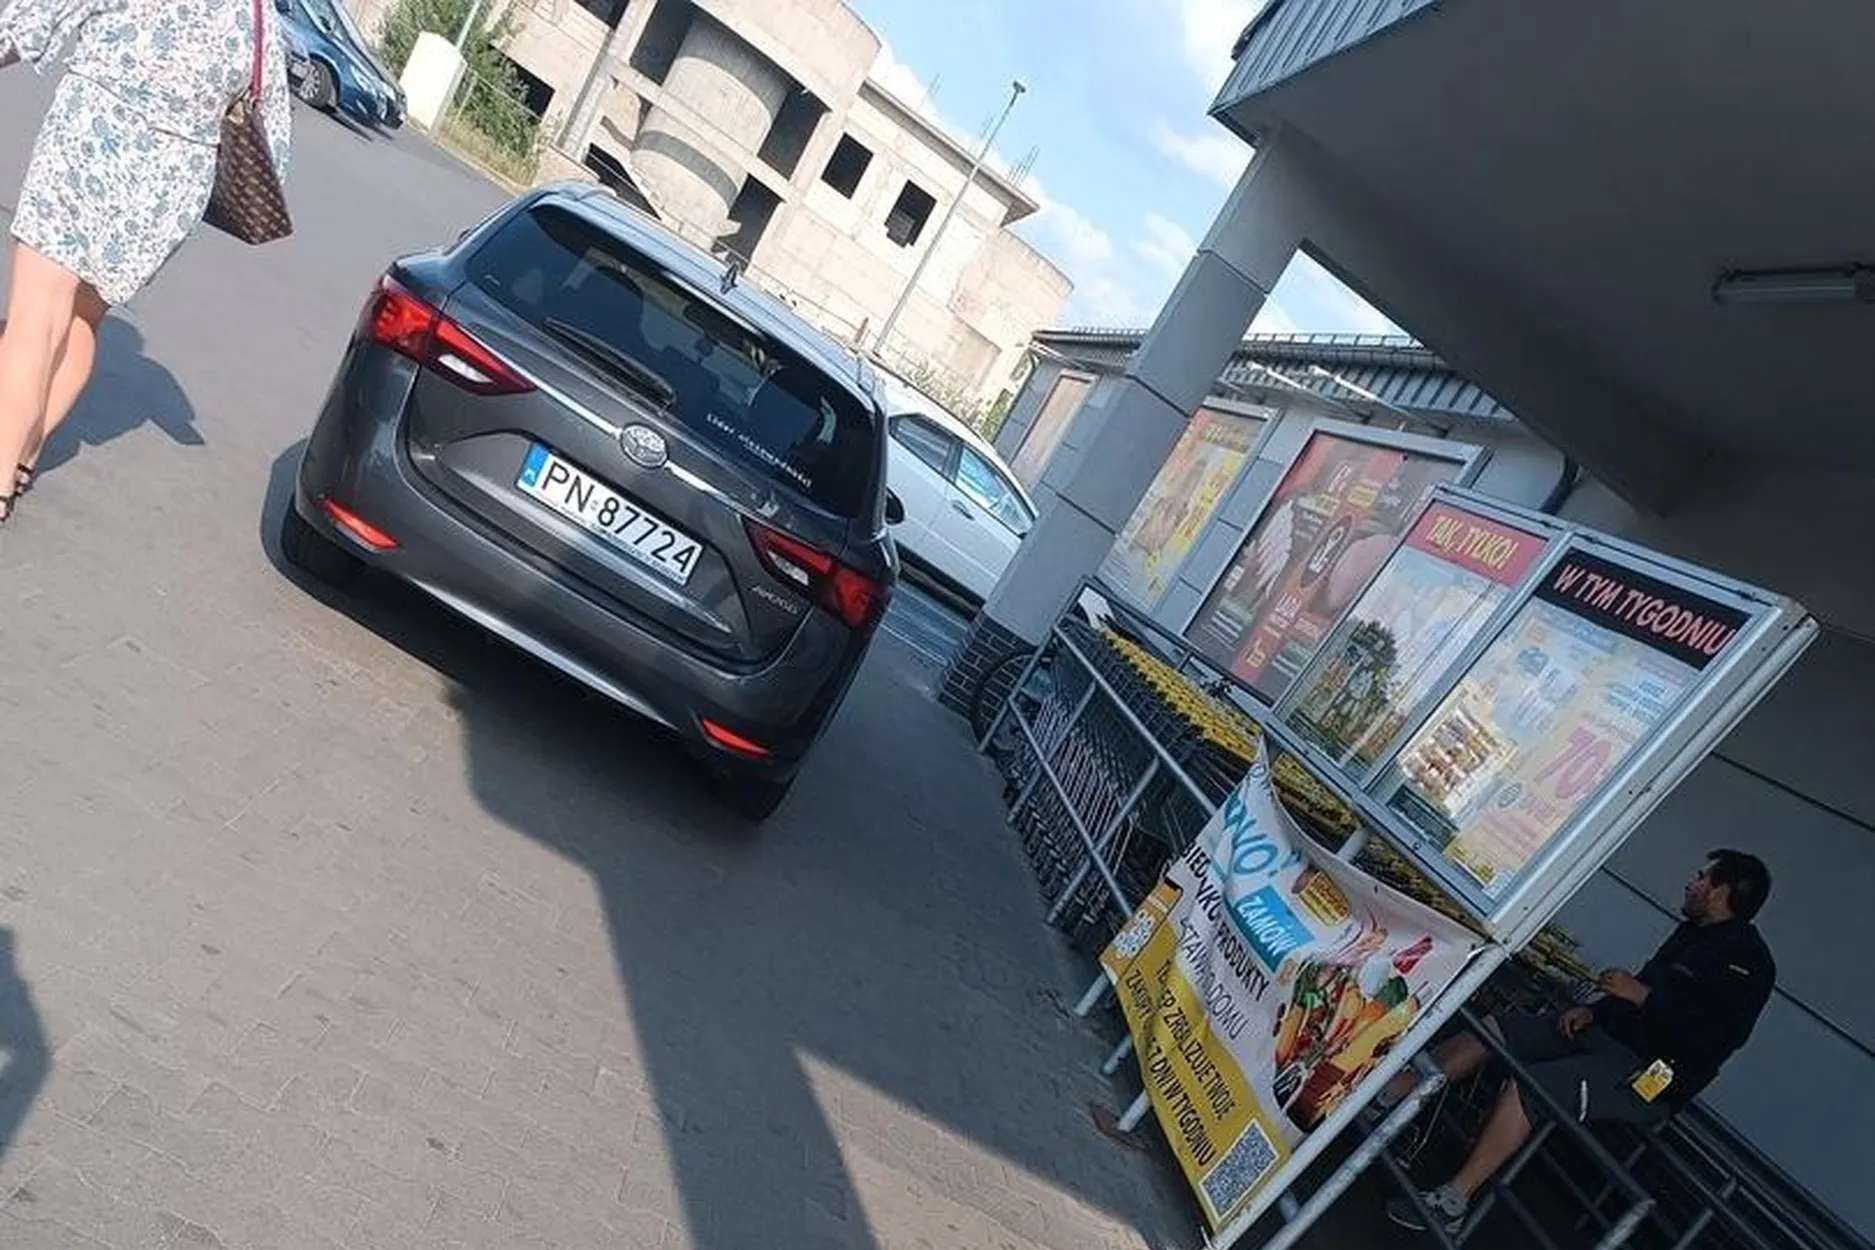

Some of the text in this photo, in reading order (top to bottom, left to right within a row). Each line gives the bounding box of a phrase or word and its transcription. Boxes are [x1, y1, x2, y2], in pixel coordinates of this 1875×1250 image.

[541, 461, 595, 514] PN
[597, 497, 696, 573] 87724
[1553, 564, 1737, 656] W TYM TYGODNIU
[1236, 894, 1297, 957] ZAMÓW
